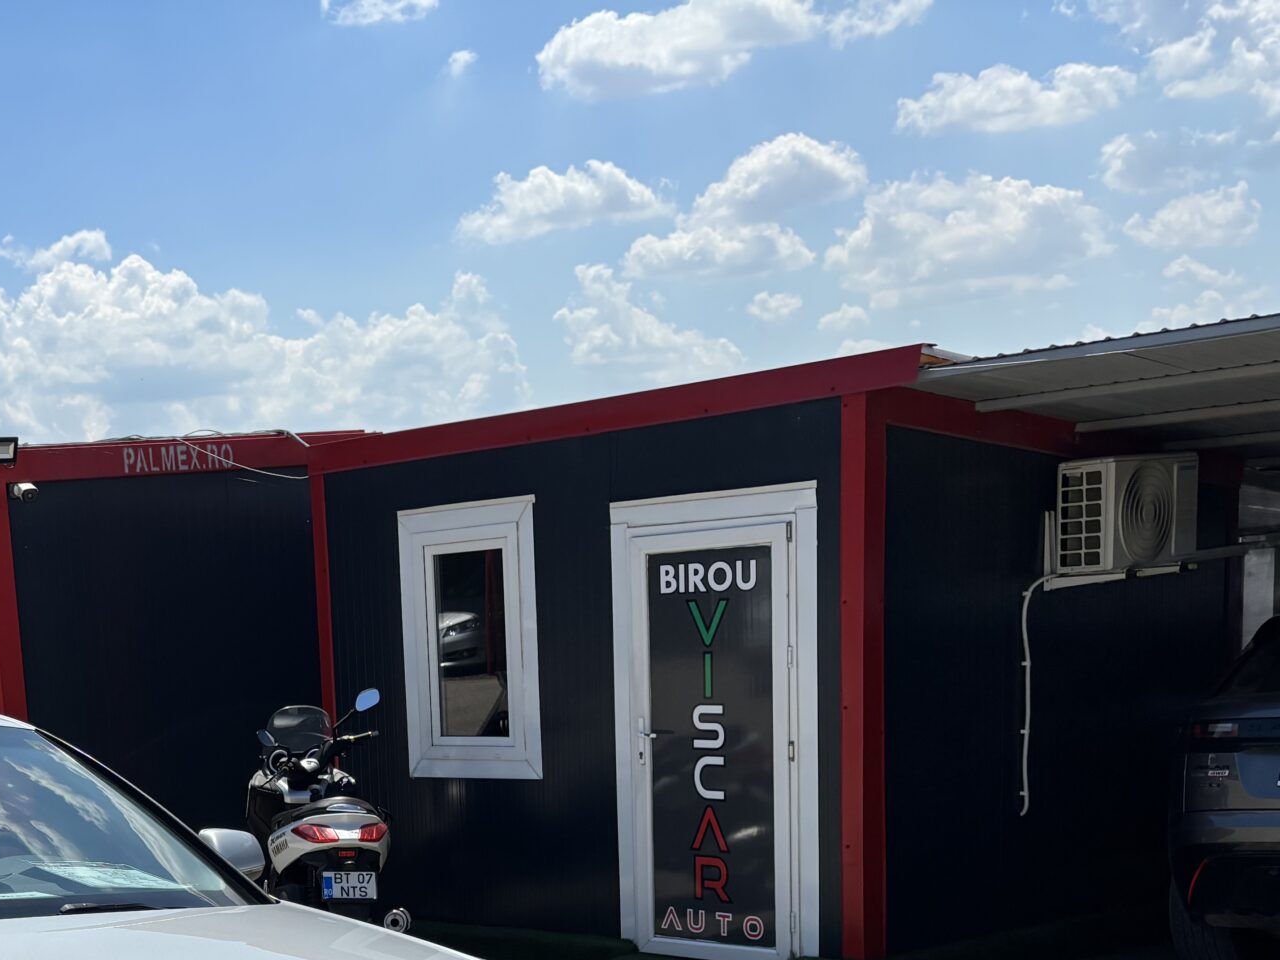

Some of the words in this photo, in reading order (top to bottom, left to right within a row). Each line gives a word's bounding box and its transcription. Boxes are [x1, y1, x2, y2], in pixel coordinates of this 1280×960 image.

[122, 443, 234, 473] PALMEX.RO
[659, 559, 758, 594] BIROU
[686, 599, 732, 903] VISCAR
[334, 873, 351, 884] BT
[357, 873, 373, 884] 07
[340, 886, 368, 897] NTS
[661, 907, 764, 940] AUTO
